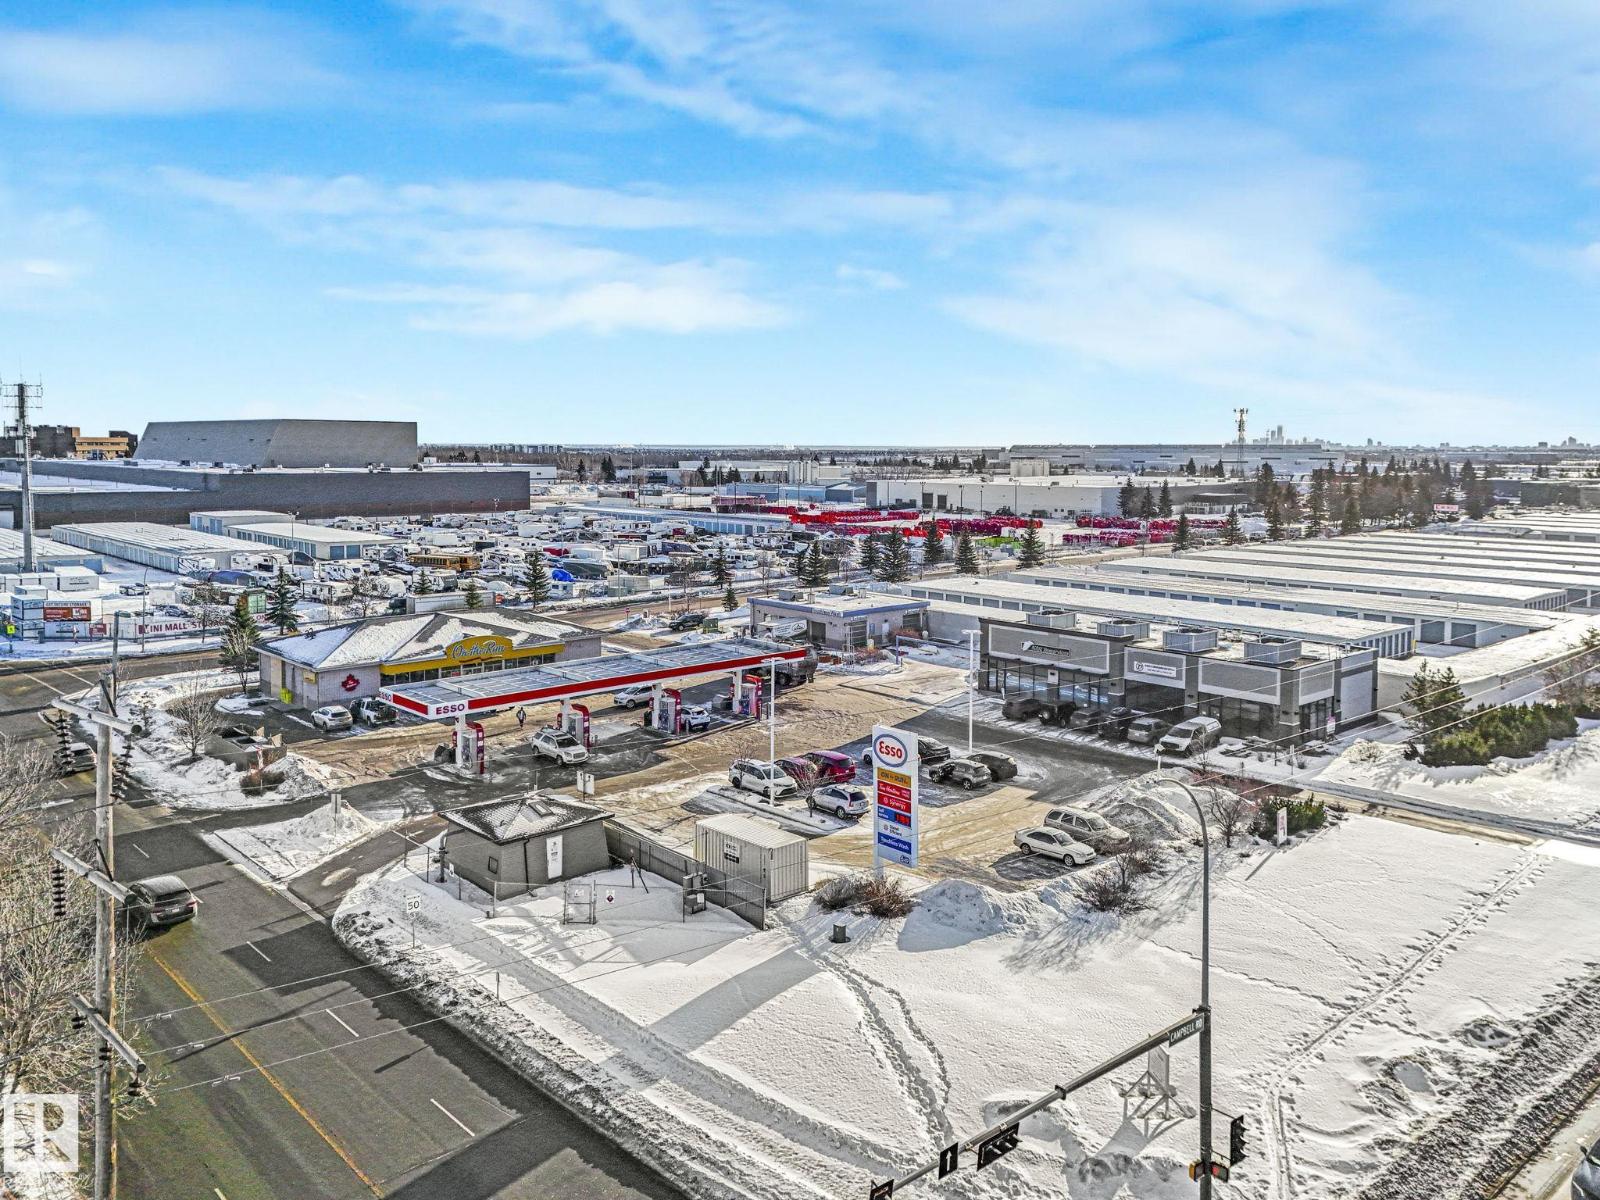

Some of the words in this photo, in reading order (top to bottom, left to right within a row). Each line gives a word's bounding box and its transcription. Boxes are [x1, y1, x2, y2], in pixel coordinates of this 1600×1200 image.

[165, 622, 188, 632] MALL
[436, 703, 465, 715] ESSO
[879, 741, 903, 759] Esso
[408, 901, 420, 910] 50
[1170, 1022, 1195, 1042] CAMPBELL
[1195, 1018, 1203, 1029] RD
